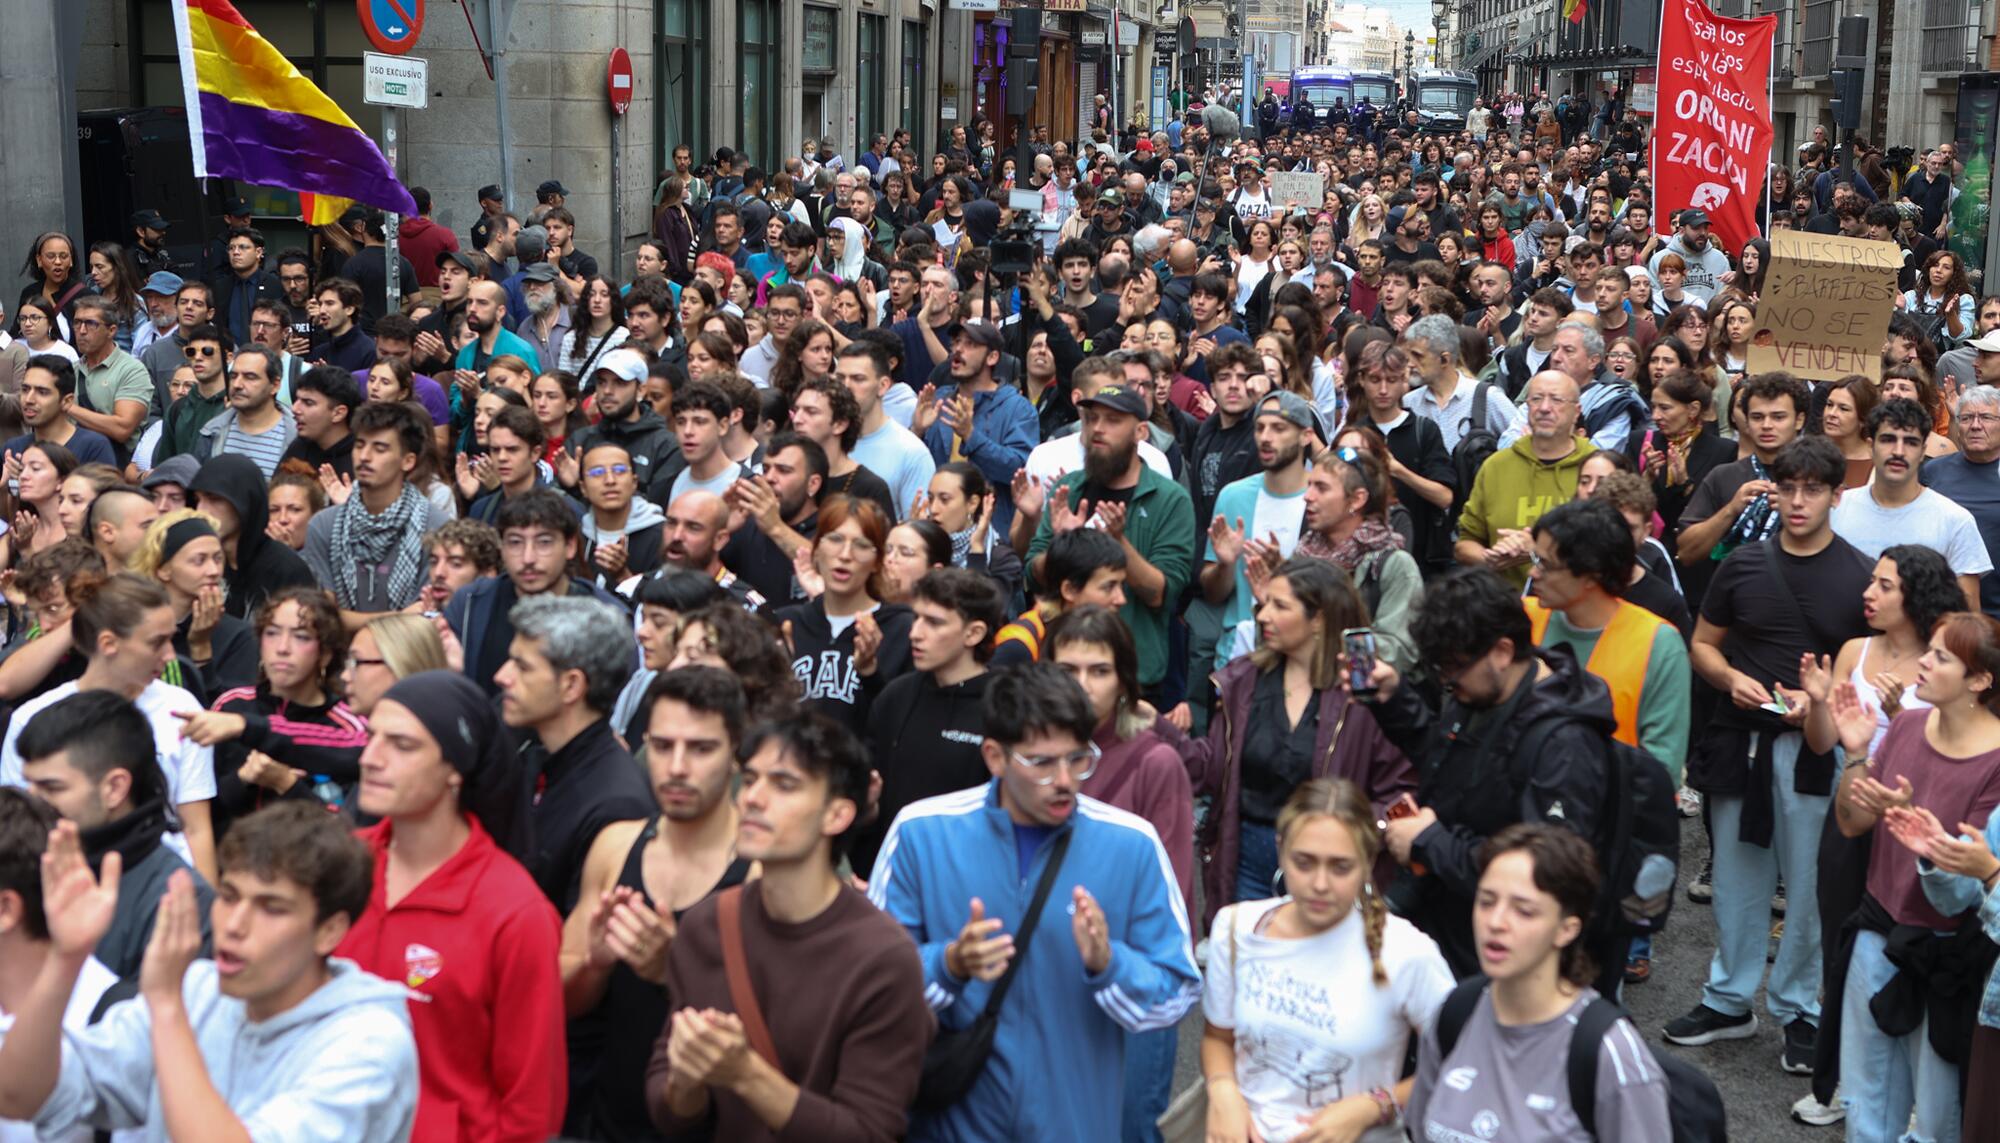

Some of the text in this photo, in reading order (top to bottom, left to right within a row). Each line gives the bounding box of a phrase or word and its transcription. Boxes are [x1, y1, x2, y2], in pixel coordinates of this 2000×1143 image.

[369, 66, 422, 79] USO EXCLUSIVO
[386, 84, 407, 95] HOTEL
[1240, 203, 1269, 217] GAZA
[1778, 240, 1894, 276] NUESTROS
[1763, 307, 1870, 336] NO SE
[1774, 340, 1867, 373] VENDEN
